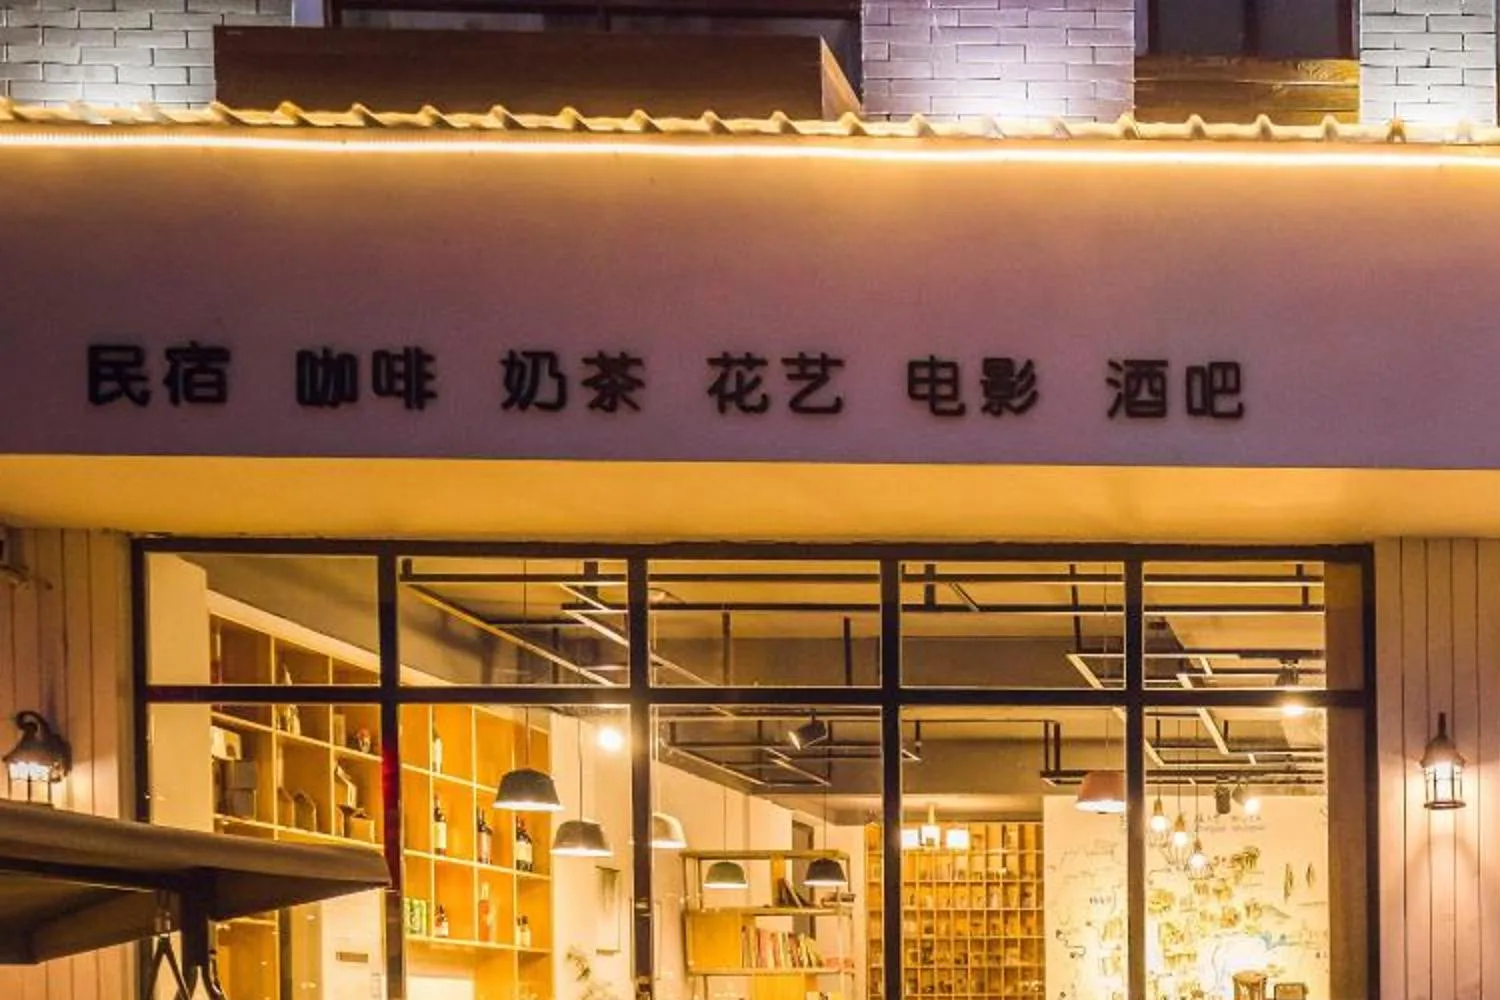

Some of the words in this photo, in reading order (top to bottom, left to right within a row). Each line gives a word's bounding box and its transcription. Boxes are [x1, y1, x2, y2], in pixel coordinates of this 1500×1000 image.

[86, 341, 232, 408] 民宿
[295, 346, 439, 411] 咖啡
[500, 348, 647, 412] 奶茶
[706, 351, 846, 416] 花艺
[907, 354, 1041, 418] 电影
[1106, 358, 1246, 420] 酒吧
